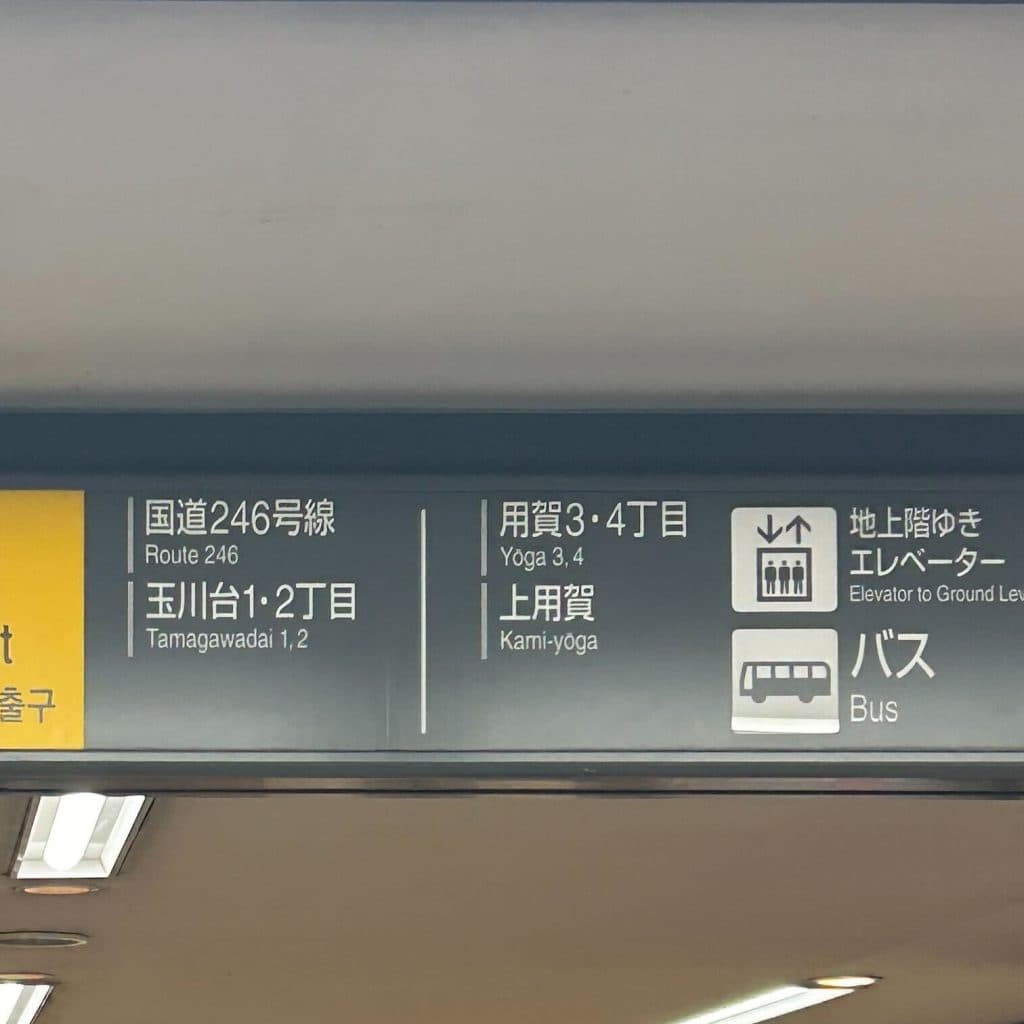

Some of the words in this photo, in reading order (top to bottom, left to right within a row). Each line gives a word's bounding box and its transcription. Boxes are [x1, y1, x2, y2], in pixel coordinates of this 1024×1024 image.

[145, 498, 336, 537] 国道246号線
[500, 500, 688, 539] 用賀3・4丁目
[849, 507, 982, 539] 地上階ゆき
[146, 545, 199, 565] Route
[204, 545, 239, 565] 246
[849, 547, 1006, 577] エレベーター
[146, 582, 357, 620] 玉川台1・2丁目
[499, 584, 595, 622] 上用賀
[850, 585, 913, 602] Elevator
[918, 586, 932, 602] to
[937, 584, 995, 602] Ground
[146, 628, 273, 652] Tamagawadai
[851, 628, 935, 679] バス
[850, 695, 898, 722] Bus
